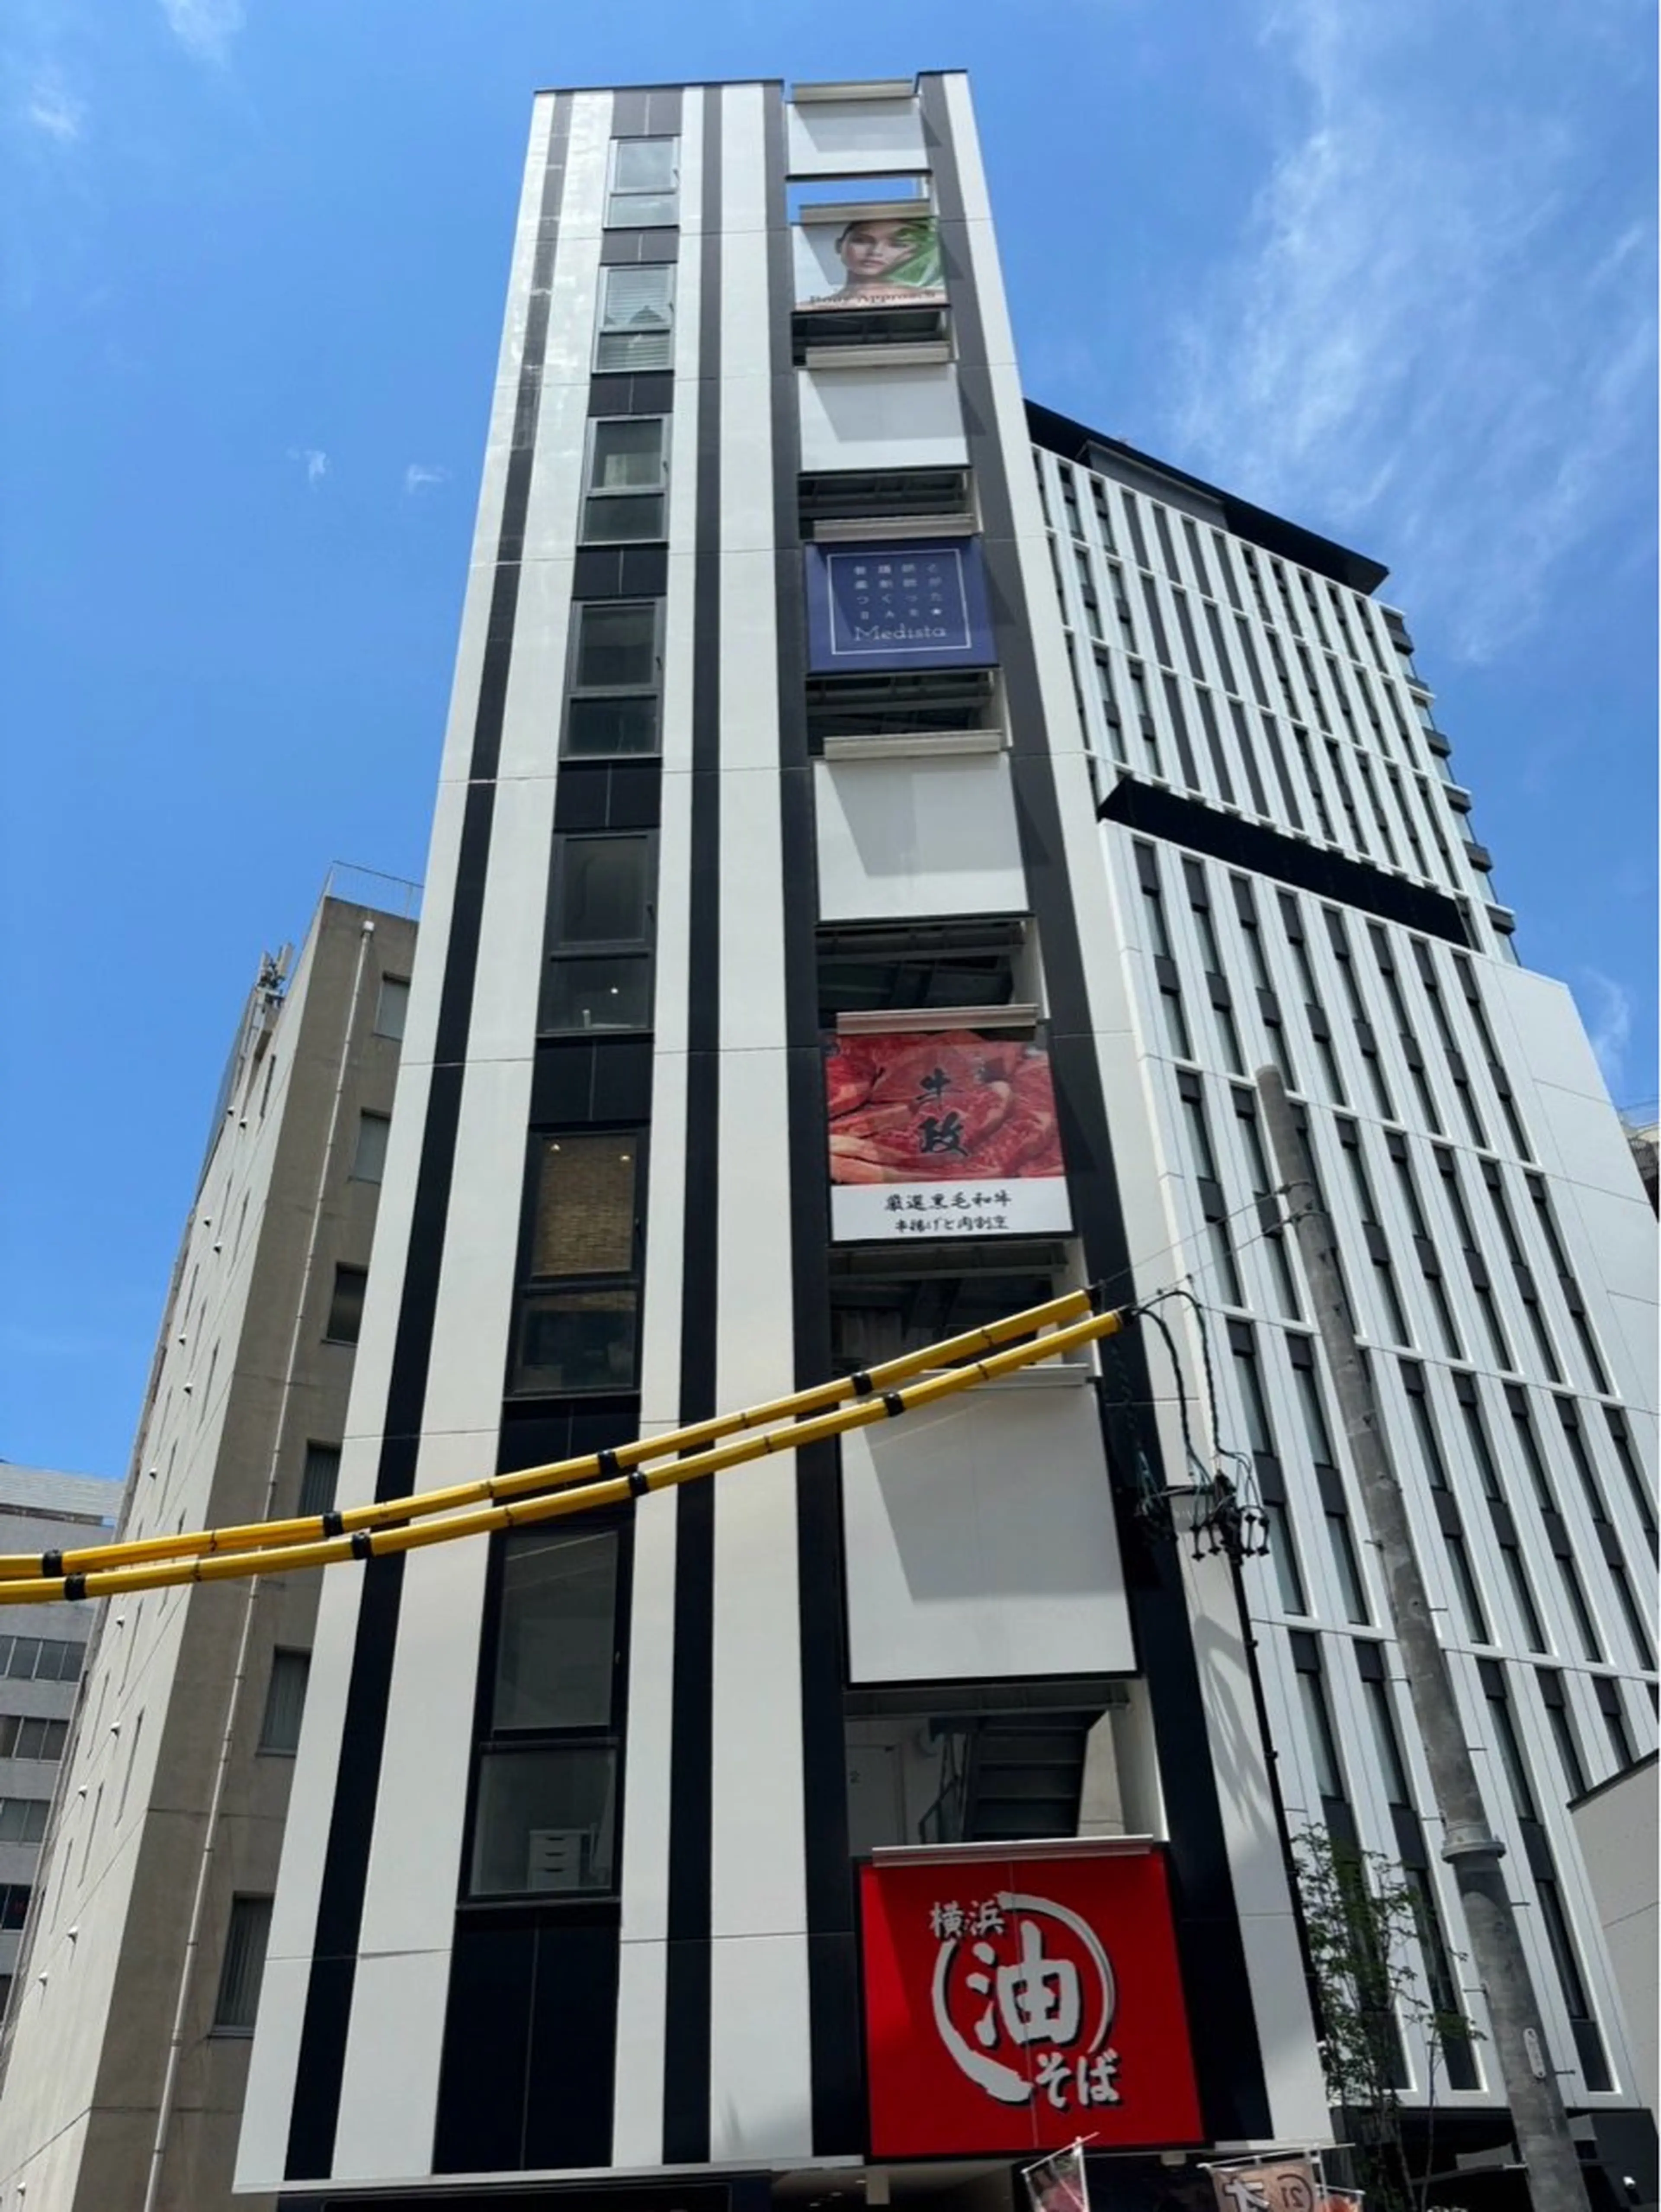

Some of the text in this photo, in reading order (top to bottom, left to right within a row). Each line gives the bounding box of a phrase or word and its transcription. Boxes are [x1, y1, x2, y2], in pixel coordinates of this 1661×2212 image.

[853, 623, 947, 641] Medista
[885, 1189, 1011, 1211] 厳選黒毛和牛
[930, 1900, 1005, 1938] 横浜
[966, 1919, 1081, 2047] 油
[1036, 2049, 1120, 2109] そば
